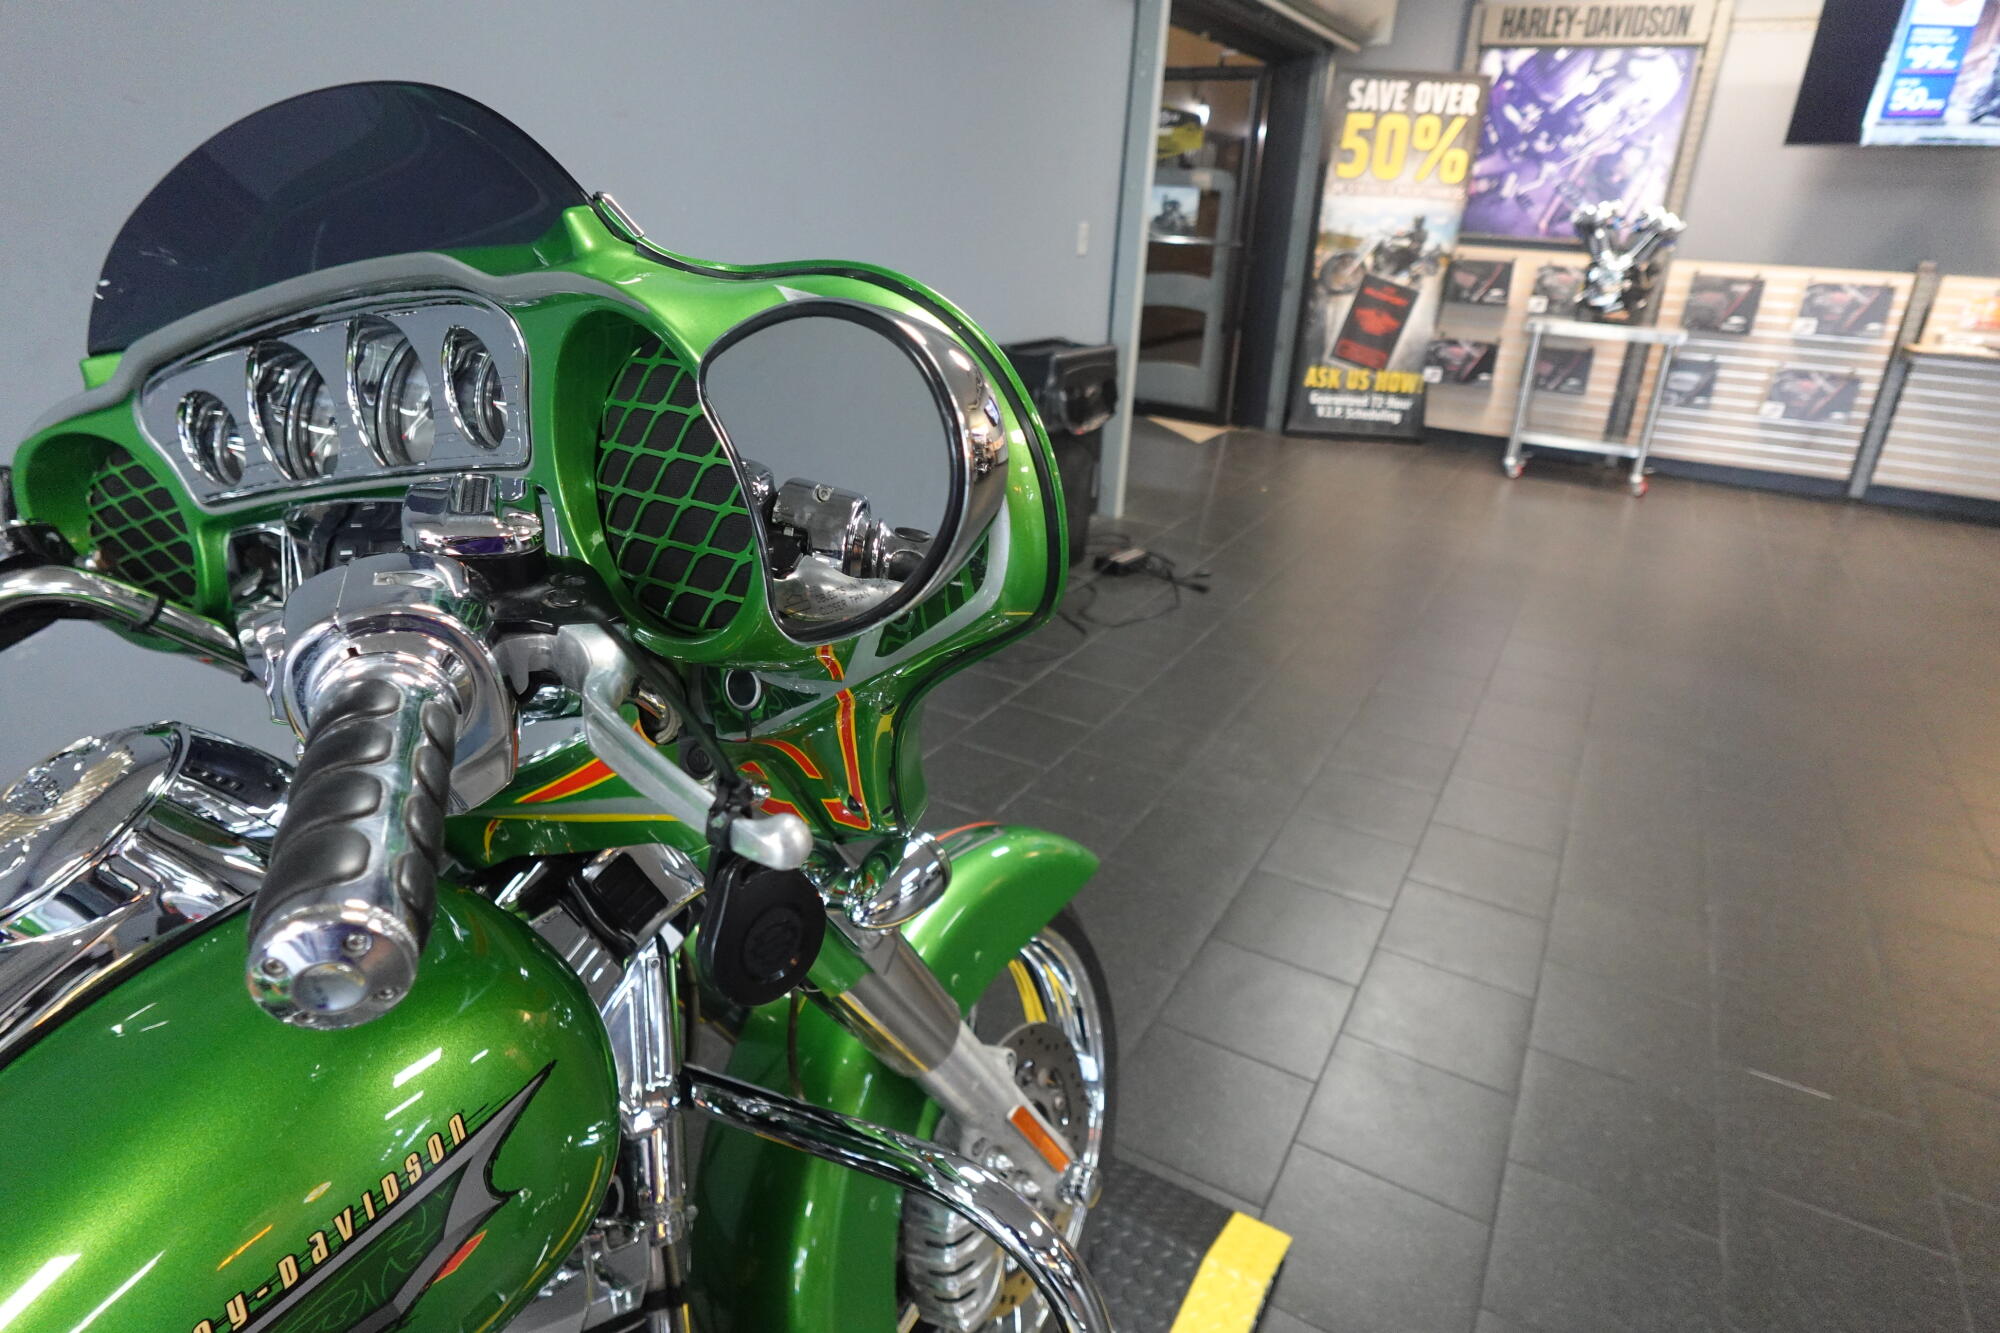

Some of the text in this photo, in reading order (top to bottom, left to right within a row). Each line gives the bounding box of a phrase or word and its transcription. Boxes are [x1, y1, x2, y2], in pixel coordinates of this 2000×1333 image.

[1499, 4, 1695, 38] HARLEY-DAVIDSON
[1347, 78, 1481, 116] SAVE OVER
[1335, 111, 1469, 185] 50%
[1304, 365, 1425, 394] ASK US NOW!
